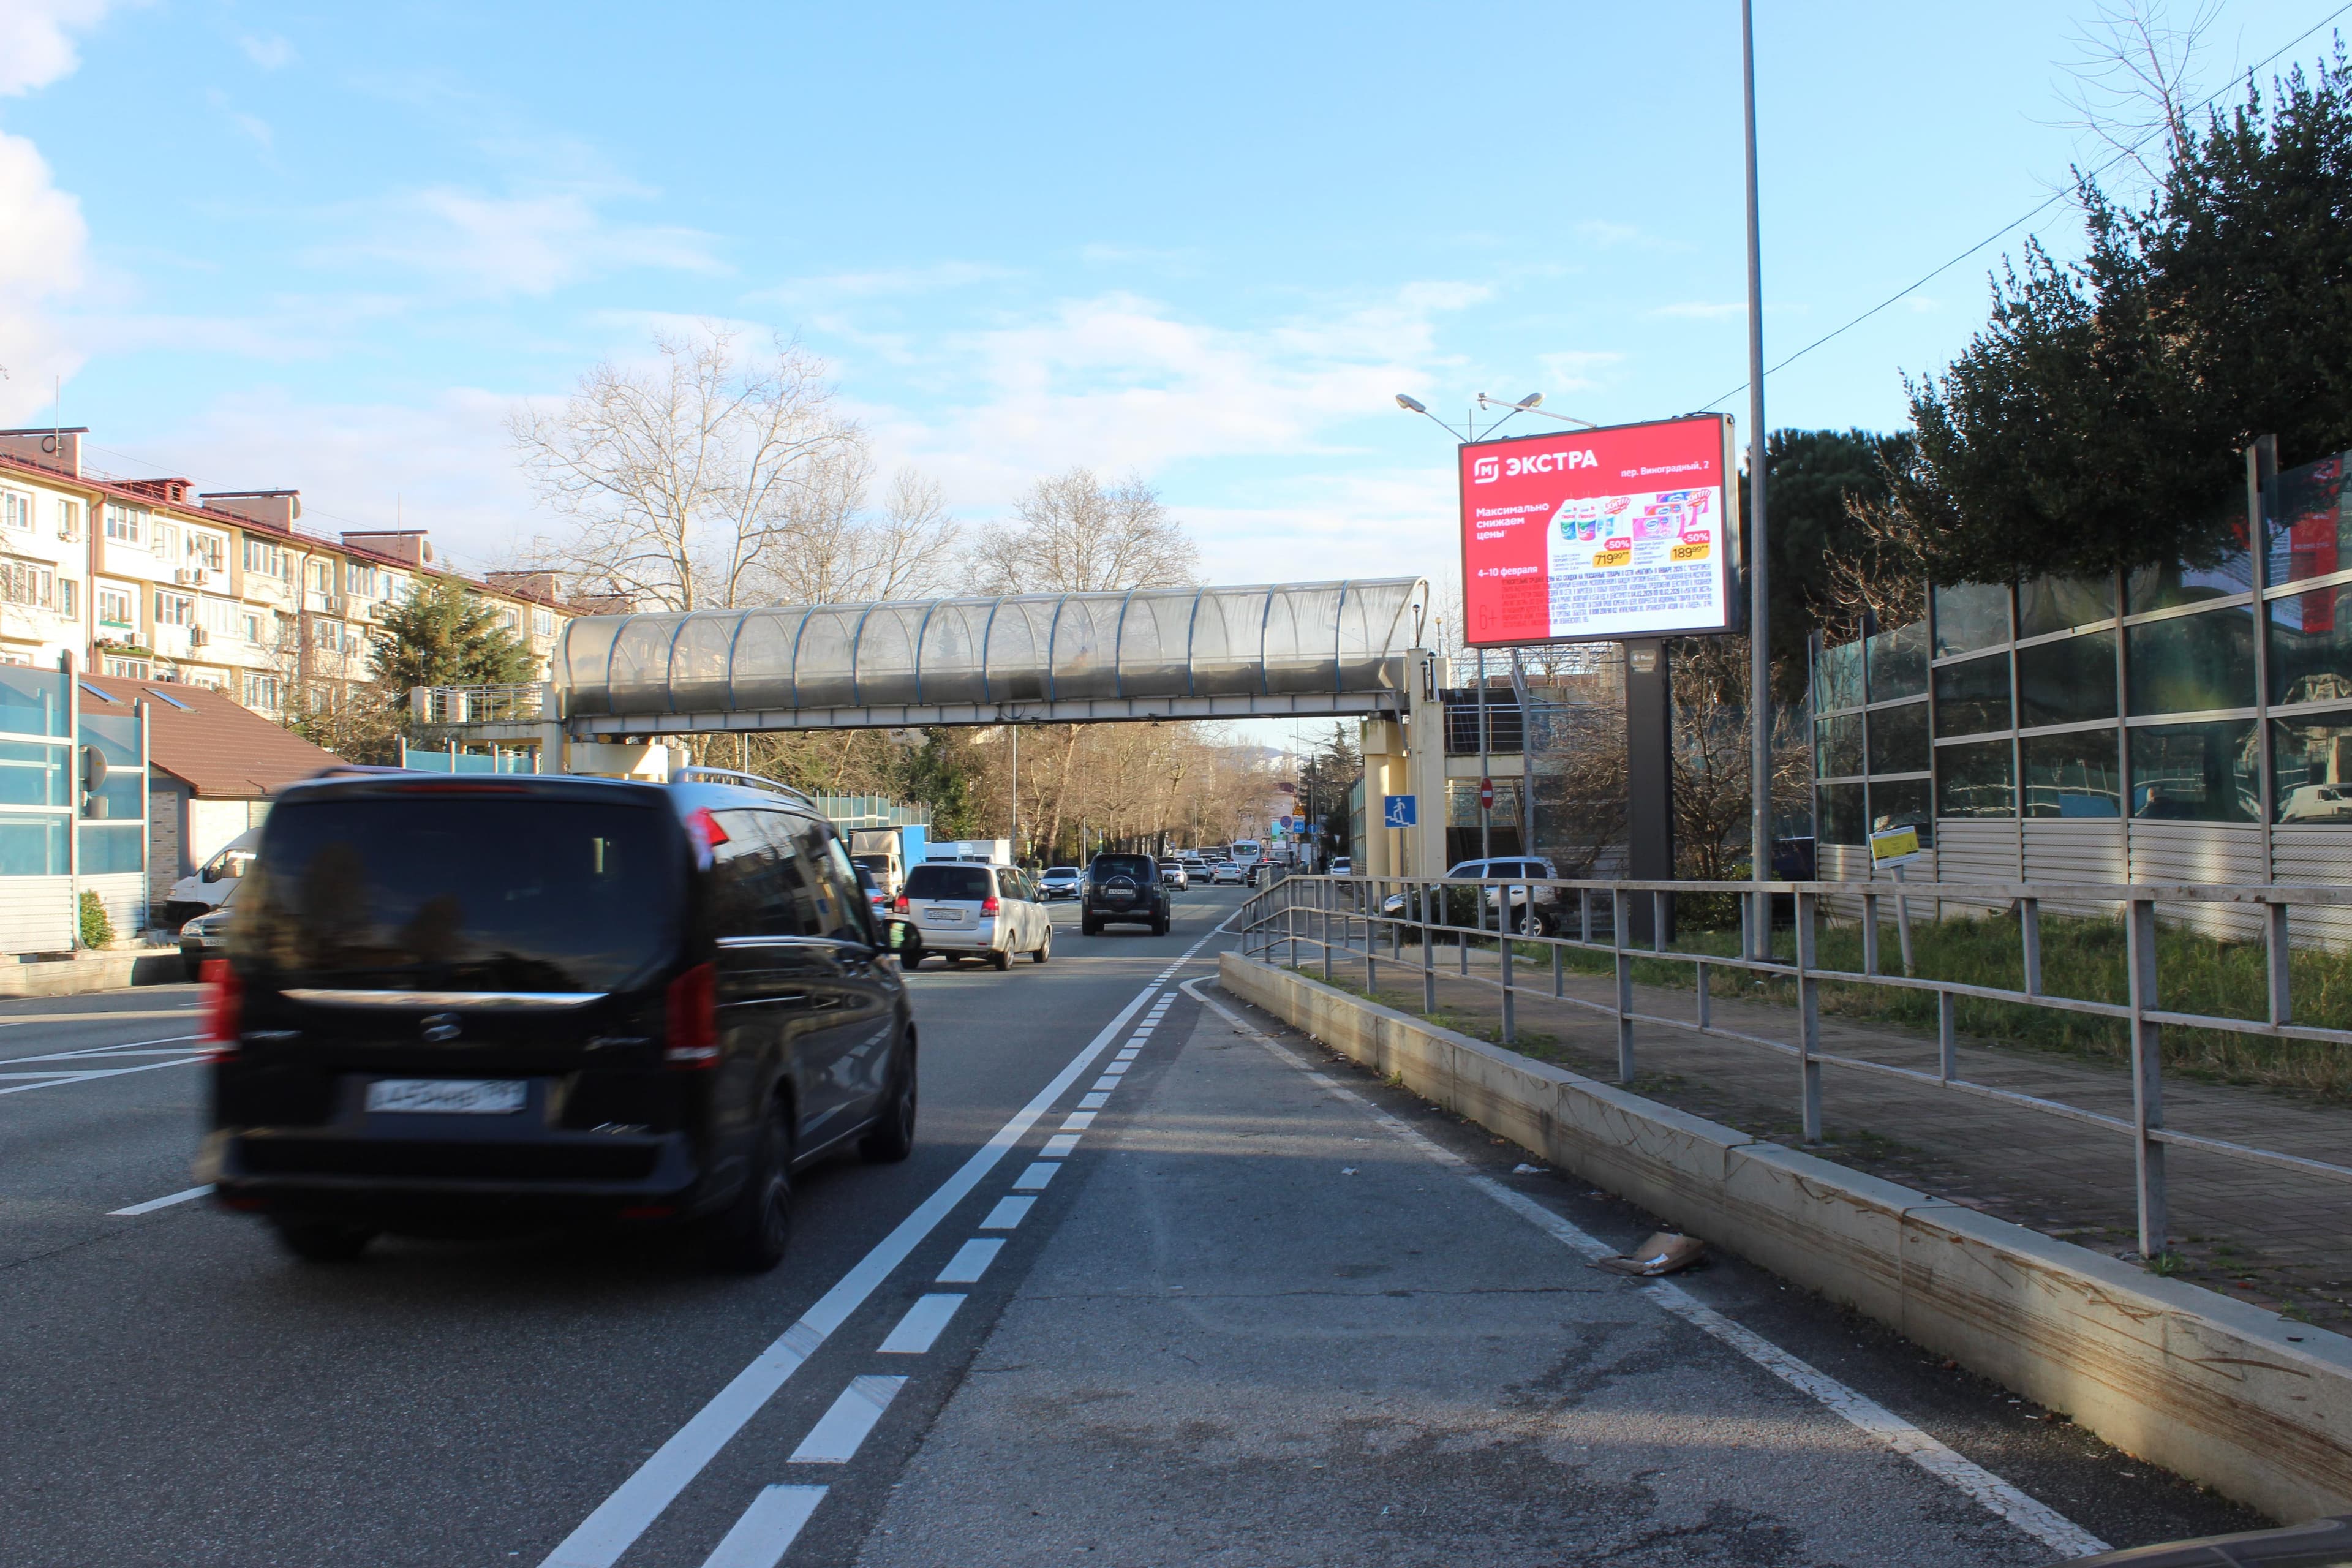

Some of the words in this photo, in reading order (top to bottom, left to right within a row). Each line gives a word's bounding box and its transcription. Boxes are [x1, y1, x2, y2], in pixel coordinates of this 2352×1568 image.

[1506, 450, 1598, 476] ЭКСТРА
[1640, 461, 1702, 475] Виноградный,
[1476, 503, 1550, 517] Максимально
[1476, 517, 1525, 528] снижаем
[1683, 533, 1709, 542] -50%
[1605, 540, 1630, 549] -50%
[1501, 565, 1538, 578] февраля
[1479, 605, 1498, 630] 6+
